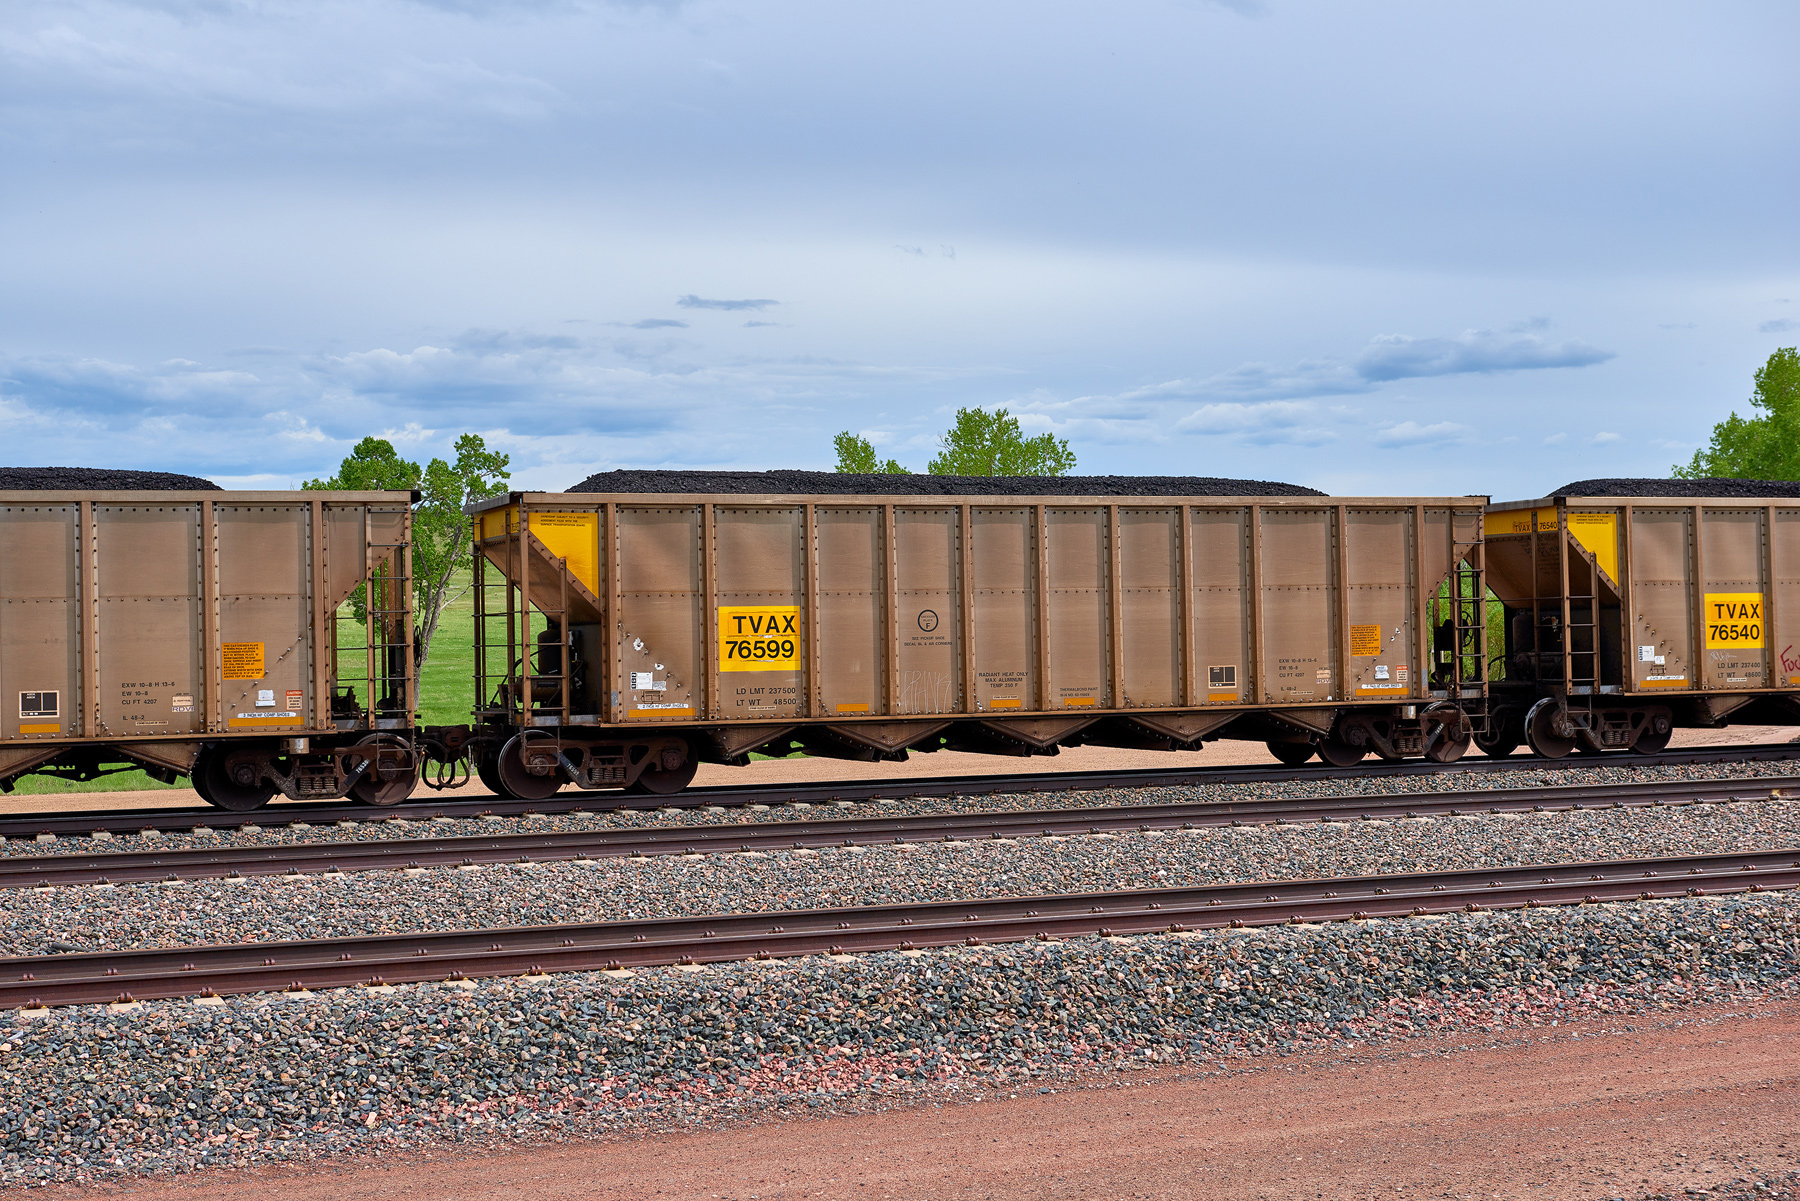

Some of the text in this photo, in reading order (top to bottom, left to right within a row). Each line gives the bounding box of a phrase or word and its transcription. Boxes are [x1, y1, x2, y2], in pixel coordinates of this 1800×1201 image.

[1539, 521, 1558, 530] 76540
[1714, 603, 1760, 619] TVAX
[732, 615, 796, 634] TVAX
[1709, 624, 1760, 640] 76540
[725, 639, 794, 659] 76599
